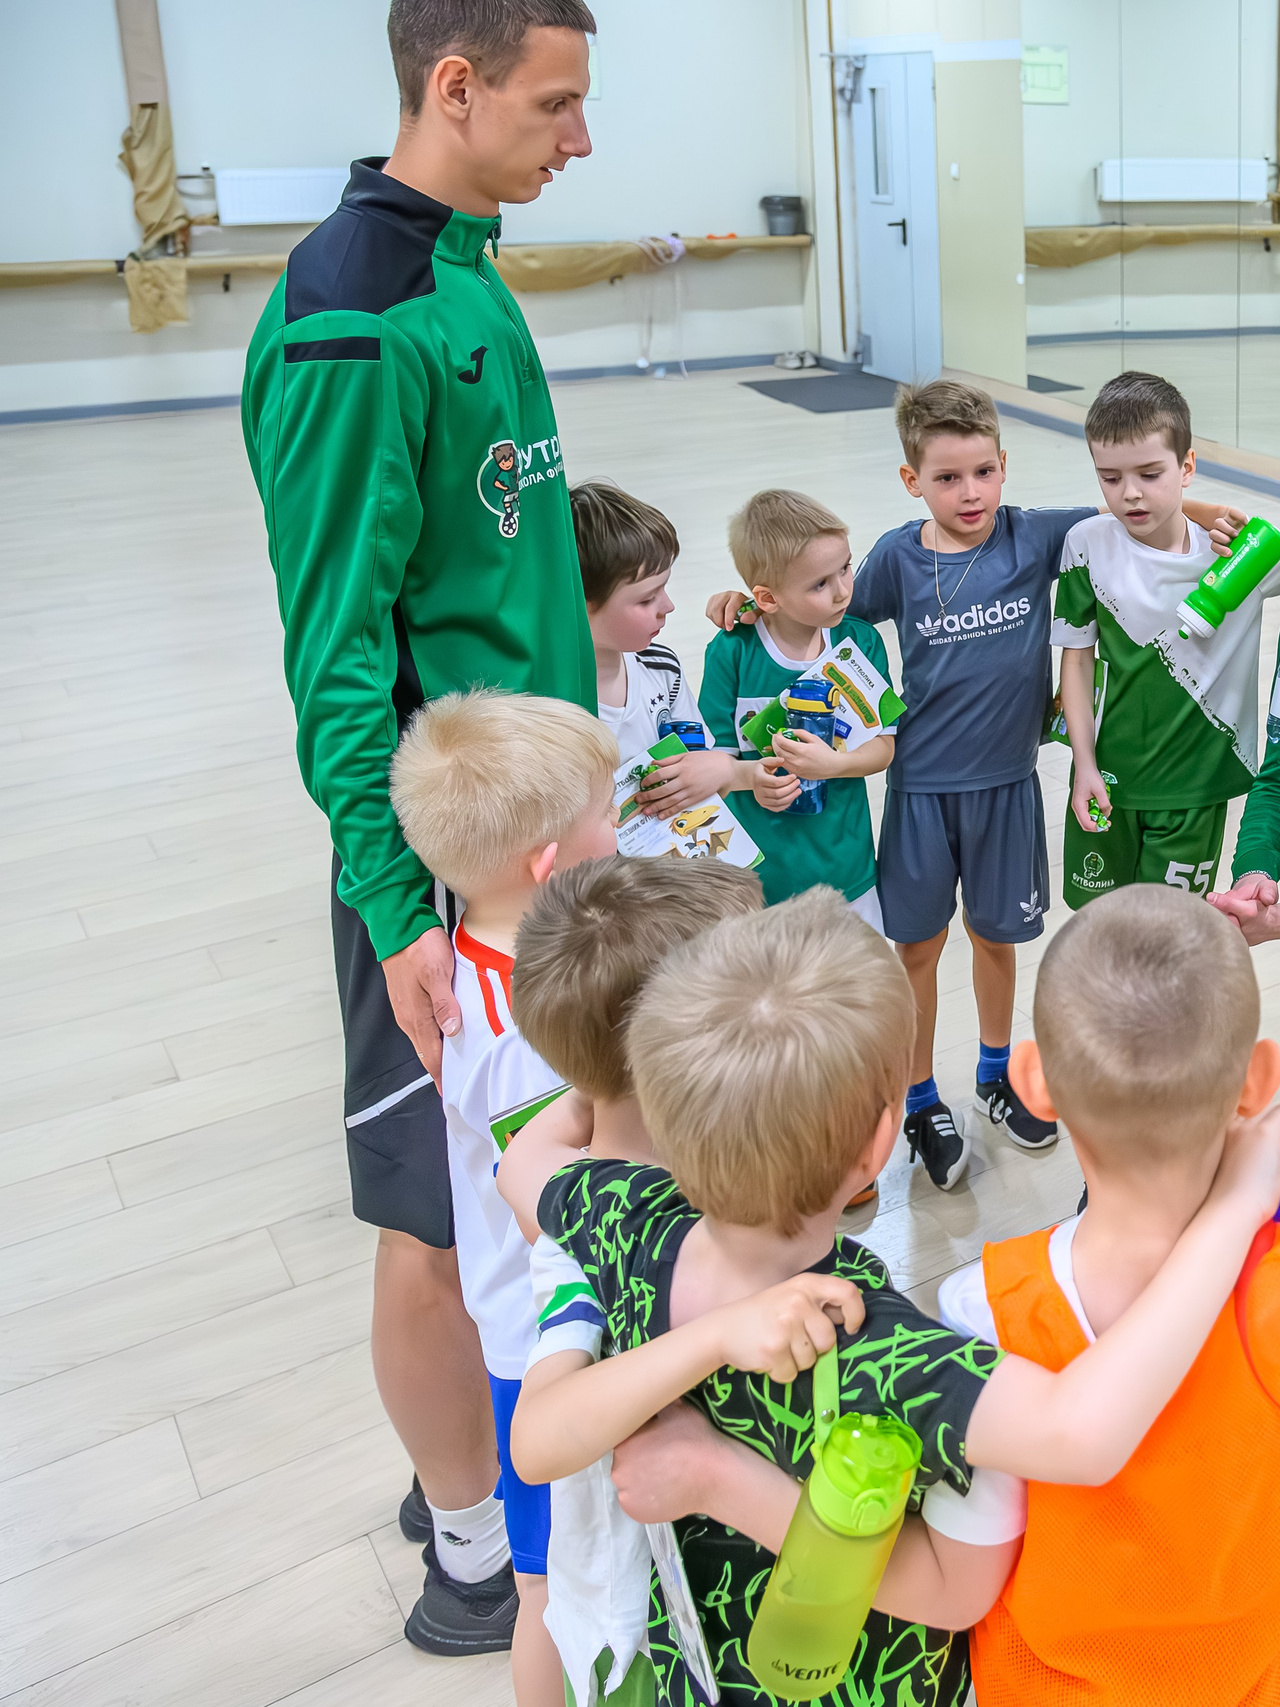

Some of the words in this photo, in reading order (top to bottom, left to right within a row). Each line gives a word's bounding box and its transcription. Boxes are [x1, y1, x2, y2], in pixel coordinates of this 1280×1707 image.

[942, 597, 1031, 633] adidas
[929, 636, 952, 646] ADIDAS
[953, 630, 987, 643] FASHION
[1165, 860, 1215, 898] 55
